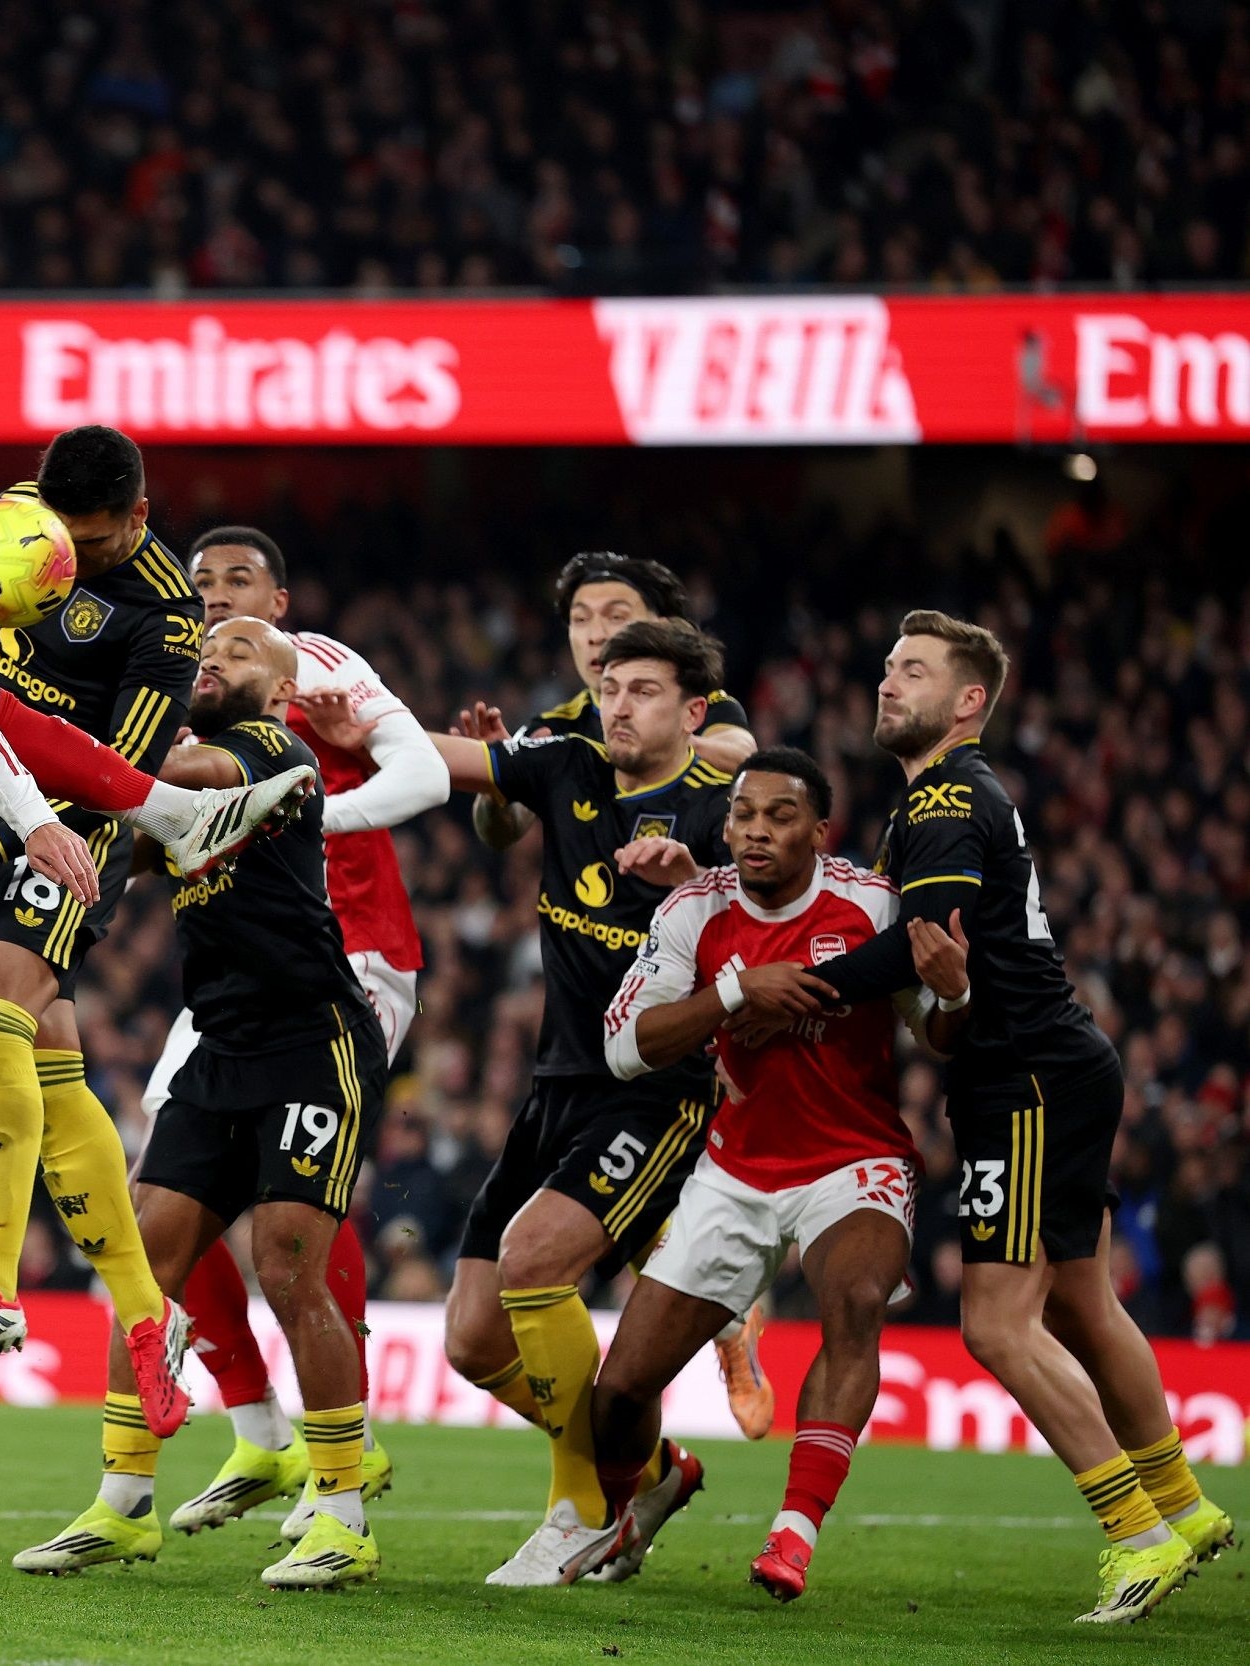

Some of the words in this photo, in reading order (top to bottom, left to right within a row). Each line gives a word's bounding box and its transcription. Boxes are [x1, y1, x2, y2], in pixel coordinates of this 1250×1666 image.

[22, 315, 461, 429] Emirates
[279, 1103, 338, 1157] 19
[598, 1130, 647, 1181] 5
[856, 1163, 906, 1198] 12
